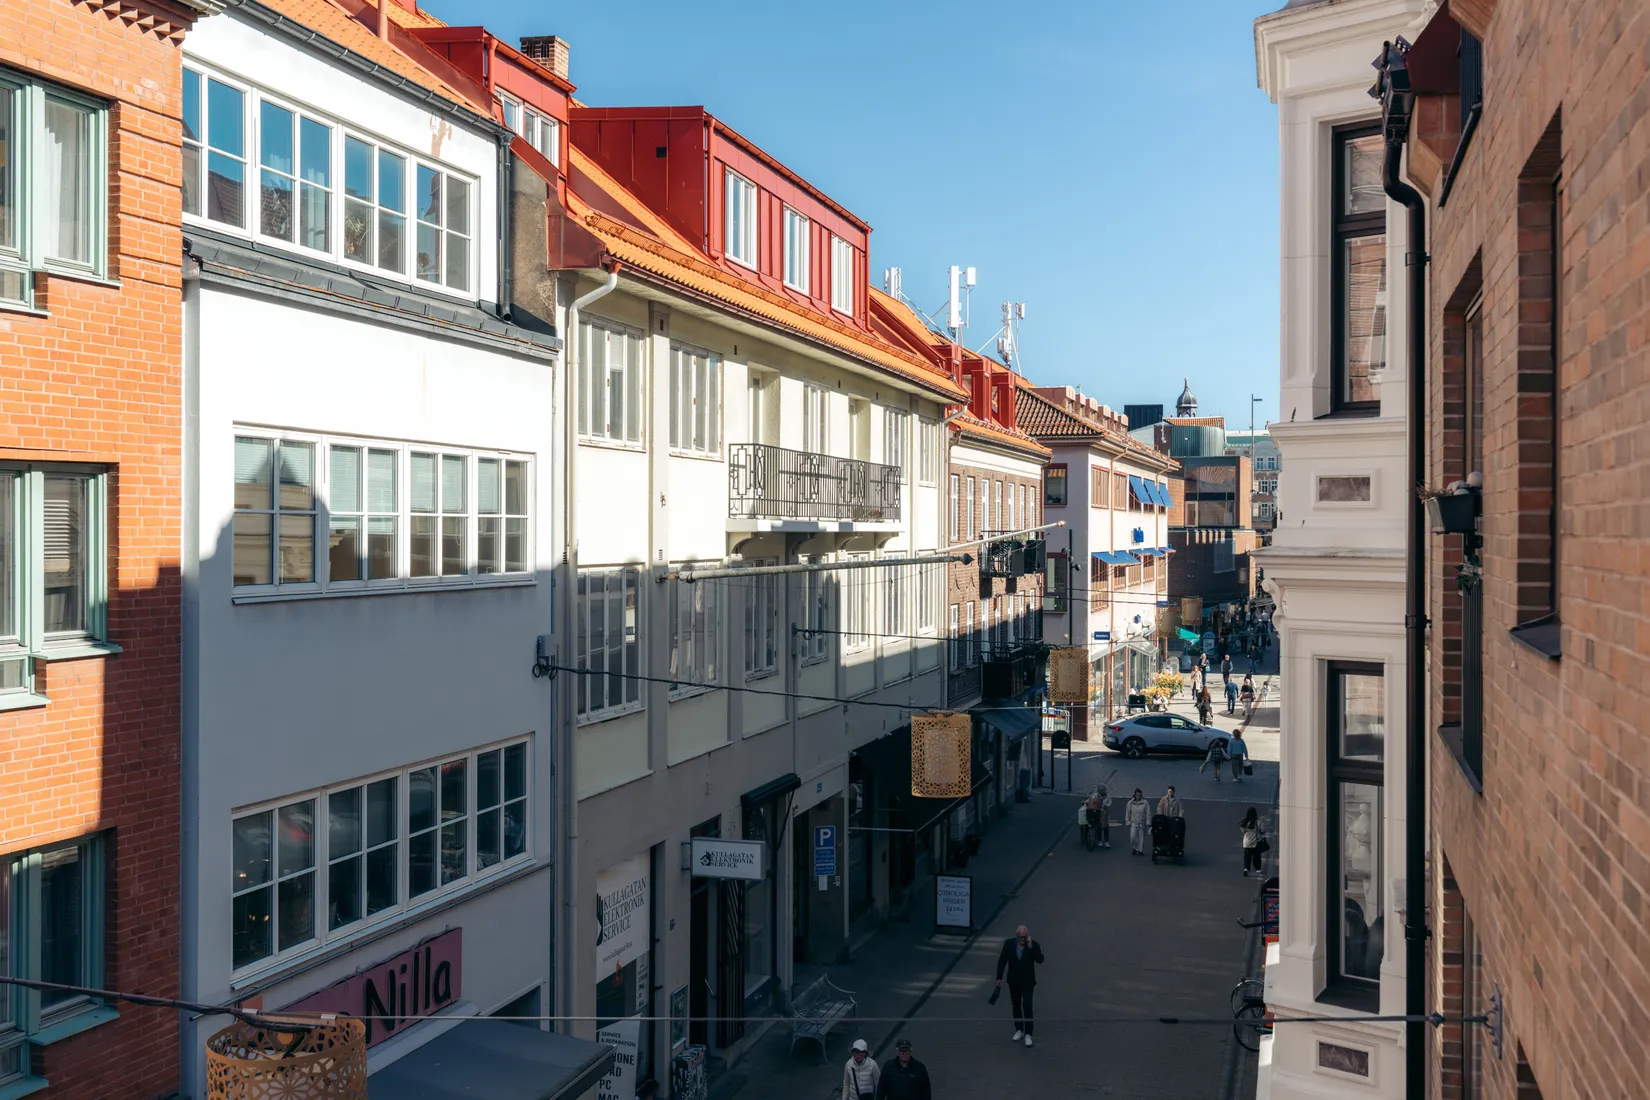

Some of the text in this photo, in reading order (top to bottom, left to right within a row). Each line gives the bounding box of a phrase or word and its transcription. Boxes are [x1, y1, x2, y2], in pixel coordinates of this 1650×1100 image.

[820, 828, 832, 846] P
[711, 851, 754, 859] KULLAGATAN
[711, 857, 754, 865] ELEKTRONIK
[603, 876, 647, 911] KULLAGATAN
[603, 892, 645, 927] ELEKTRONIK
[603, 914, 632, 943] SERVICE
[365, 946, 452, 1044] Nilla
[606, 1038, 636, 1048] REPARATION
[599, 1079, 612, 1090] PC
